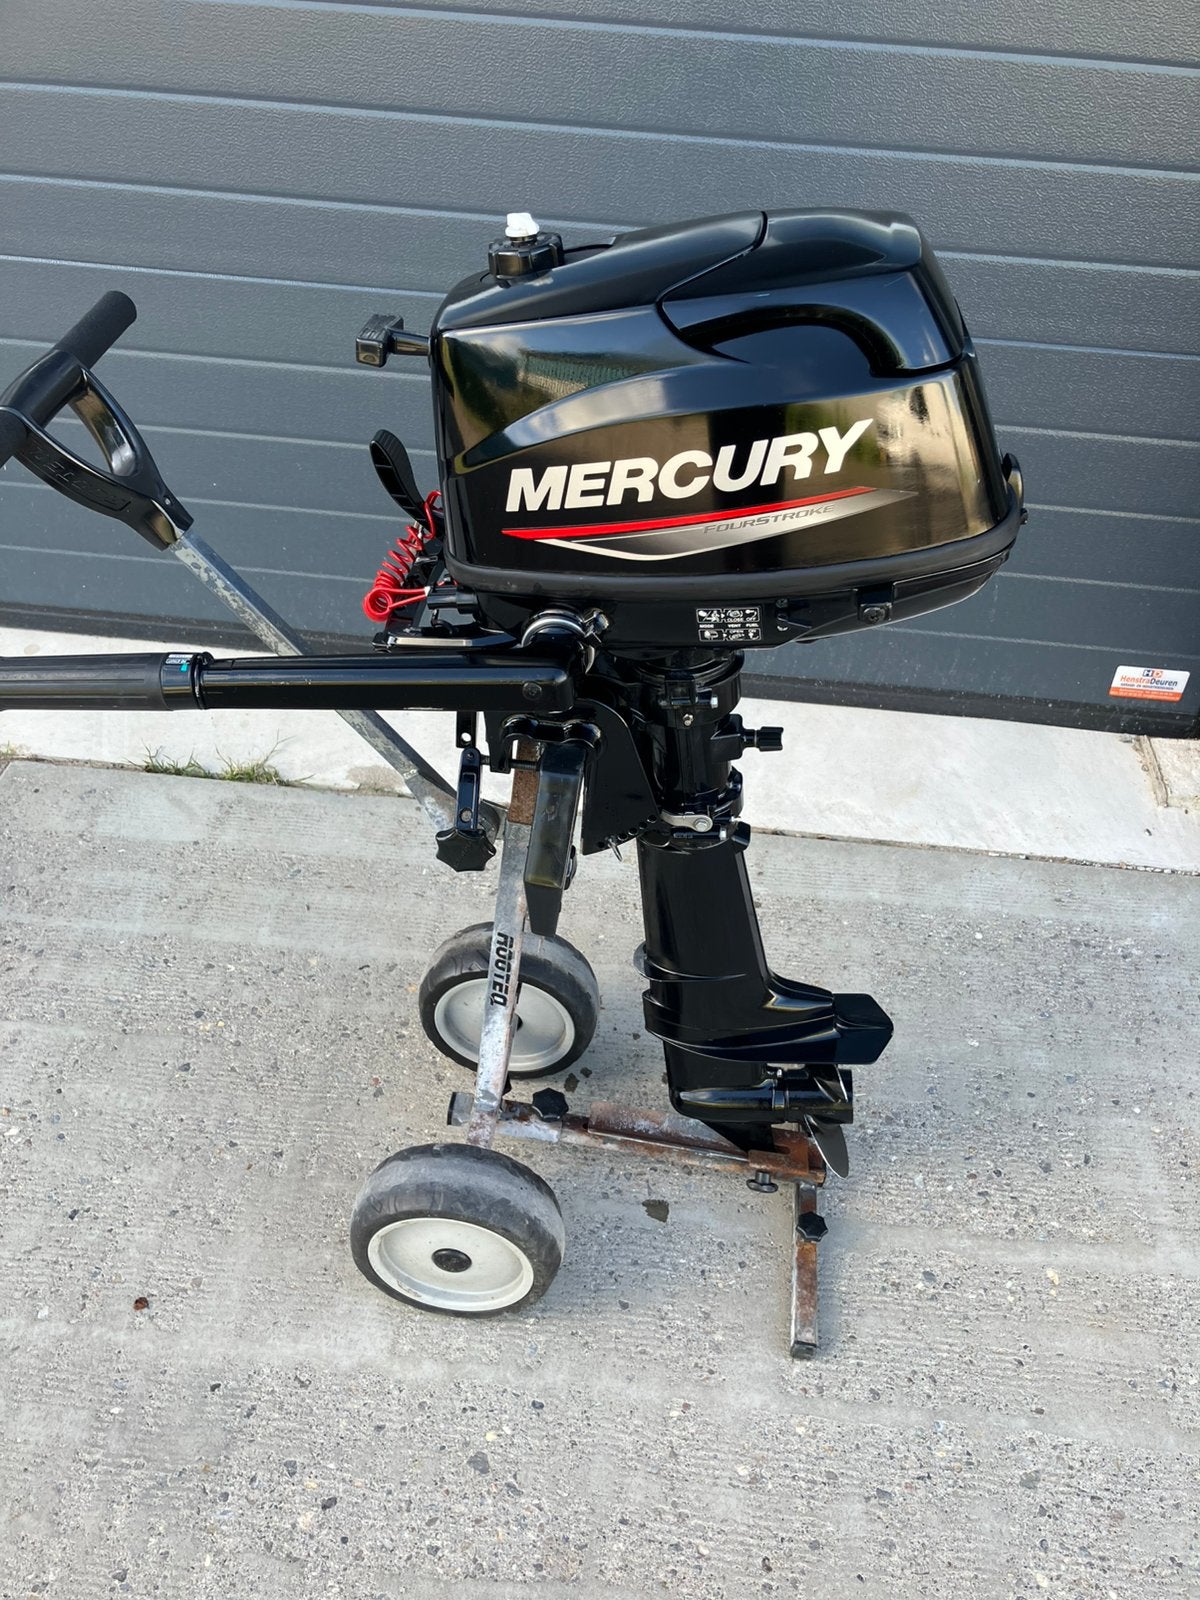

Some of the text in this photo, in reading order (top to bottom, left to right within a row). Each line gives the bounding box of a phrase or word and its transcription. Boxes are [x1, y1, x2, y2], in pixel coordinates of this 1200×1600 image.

[506, 418, 873, 512] MERCURY
[704, 504, 835, 533] FOURSTROKE
[1120, 675, 1178, 687] HenstraDeuren
[489, 932, 514, 1006] ROOTEQ
